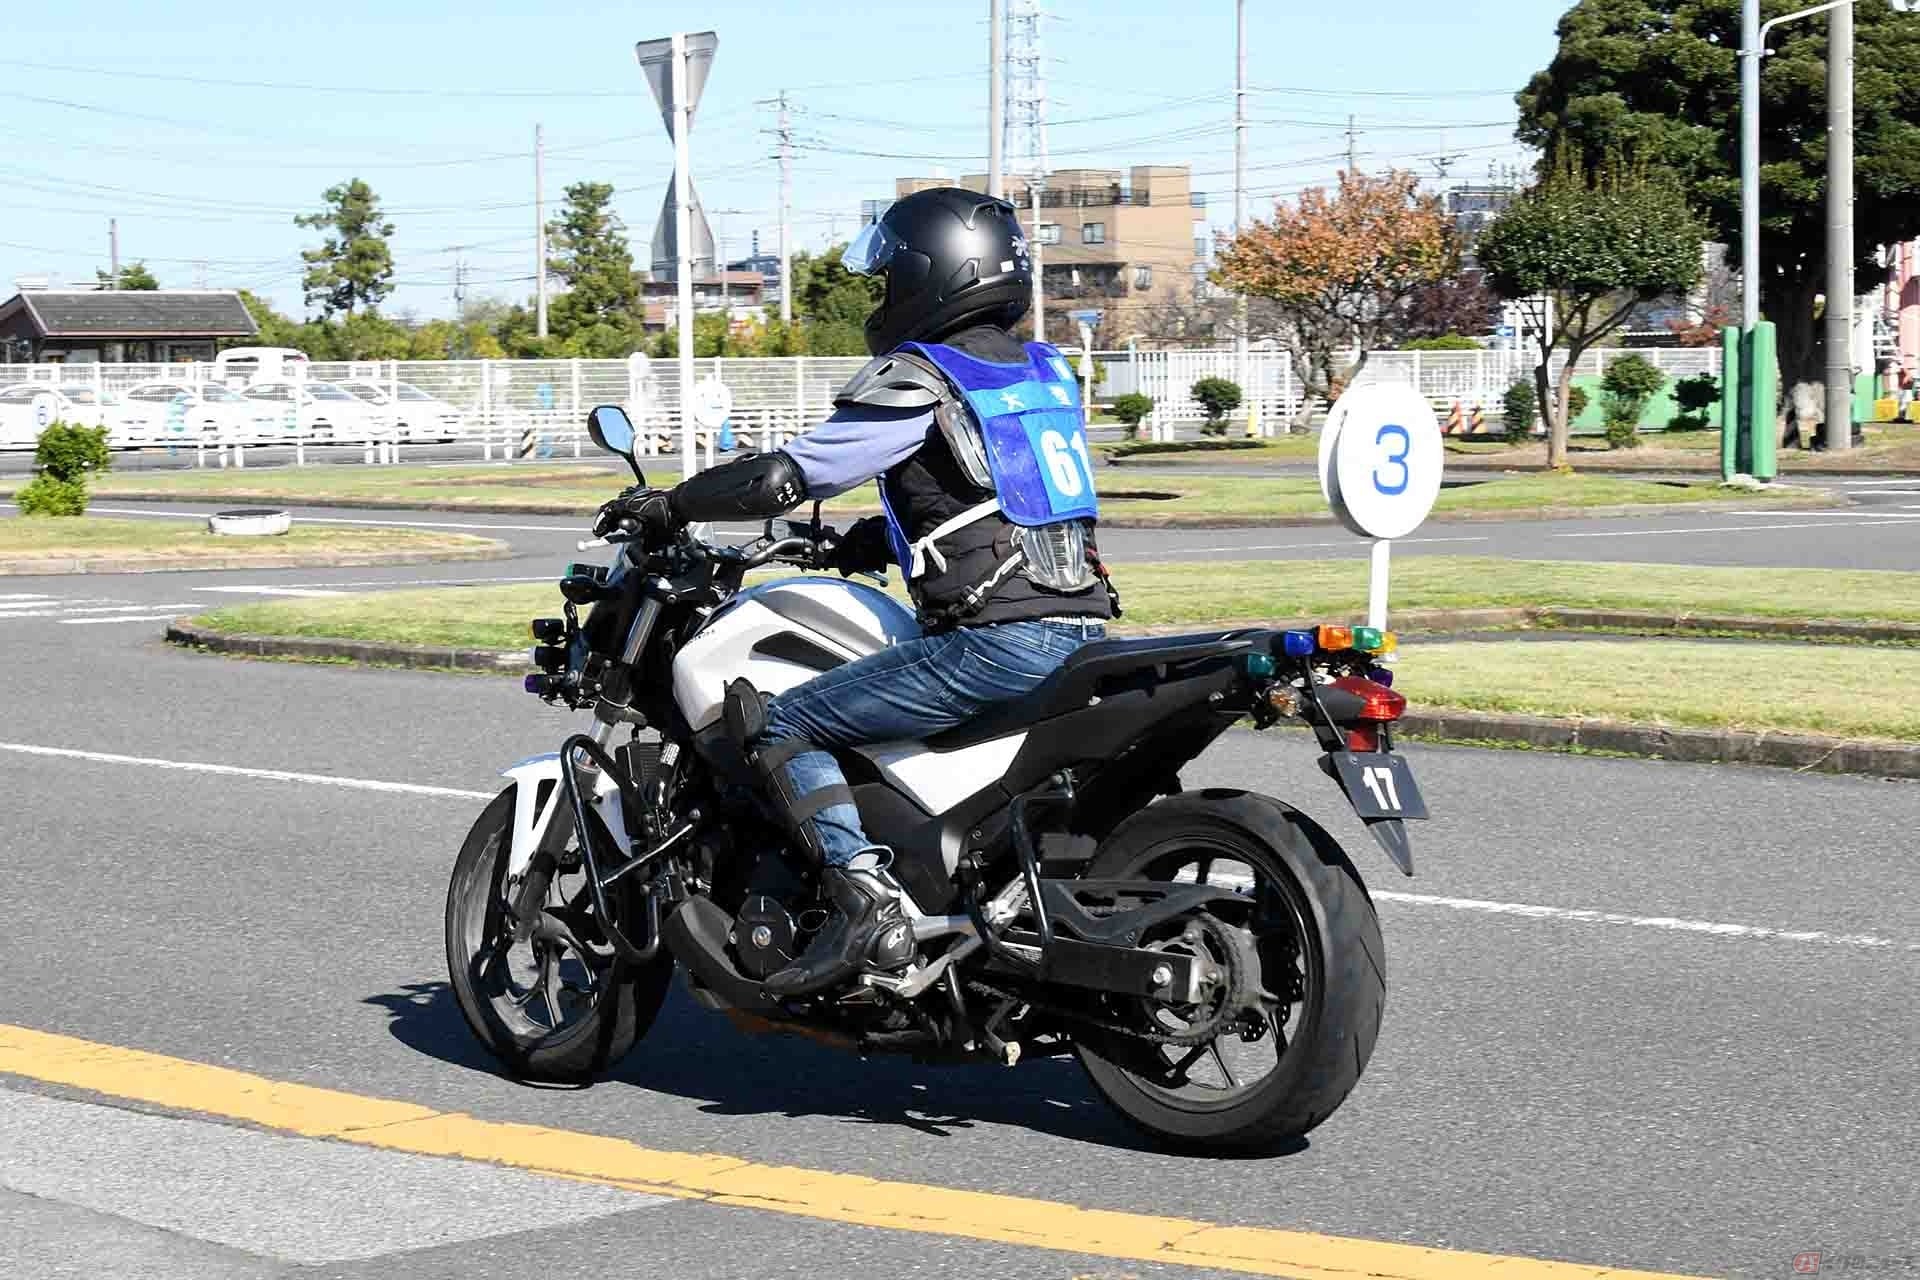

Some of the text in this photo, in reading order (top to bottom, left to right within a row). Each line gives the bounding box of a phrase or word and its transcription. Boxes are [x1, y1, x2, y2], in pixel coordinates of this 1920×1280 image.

[1040, 430, 1095, 497] 61
[1373, 425, 1410, 495] 3
[1363, 766, 1402, 811] 17
